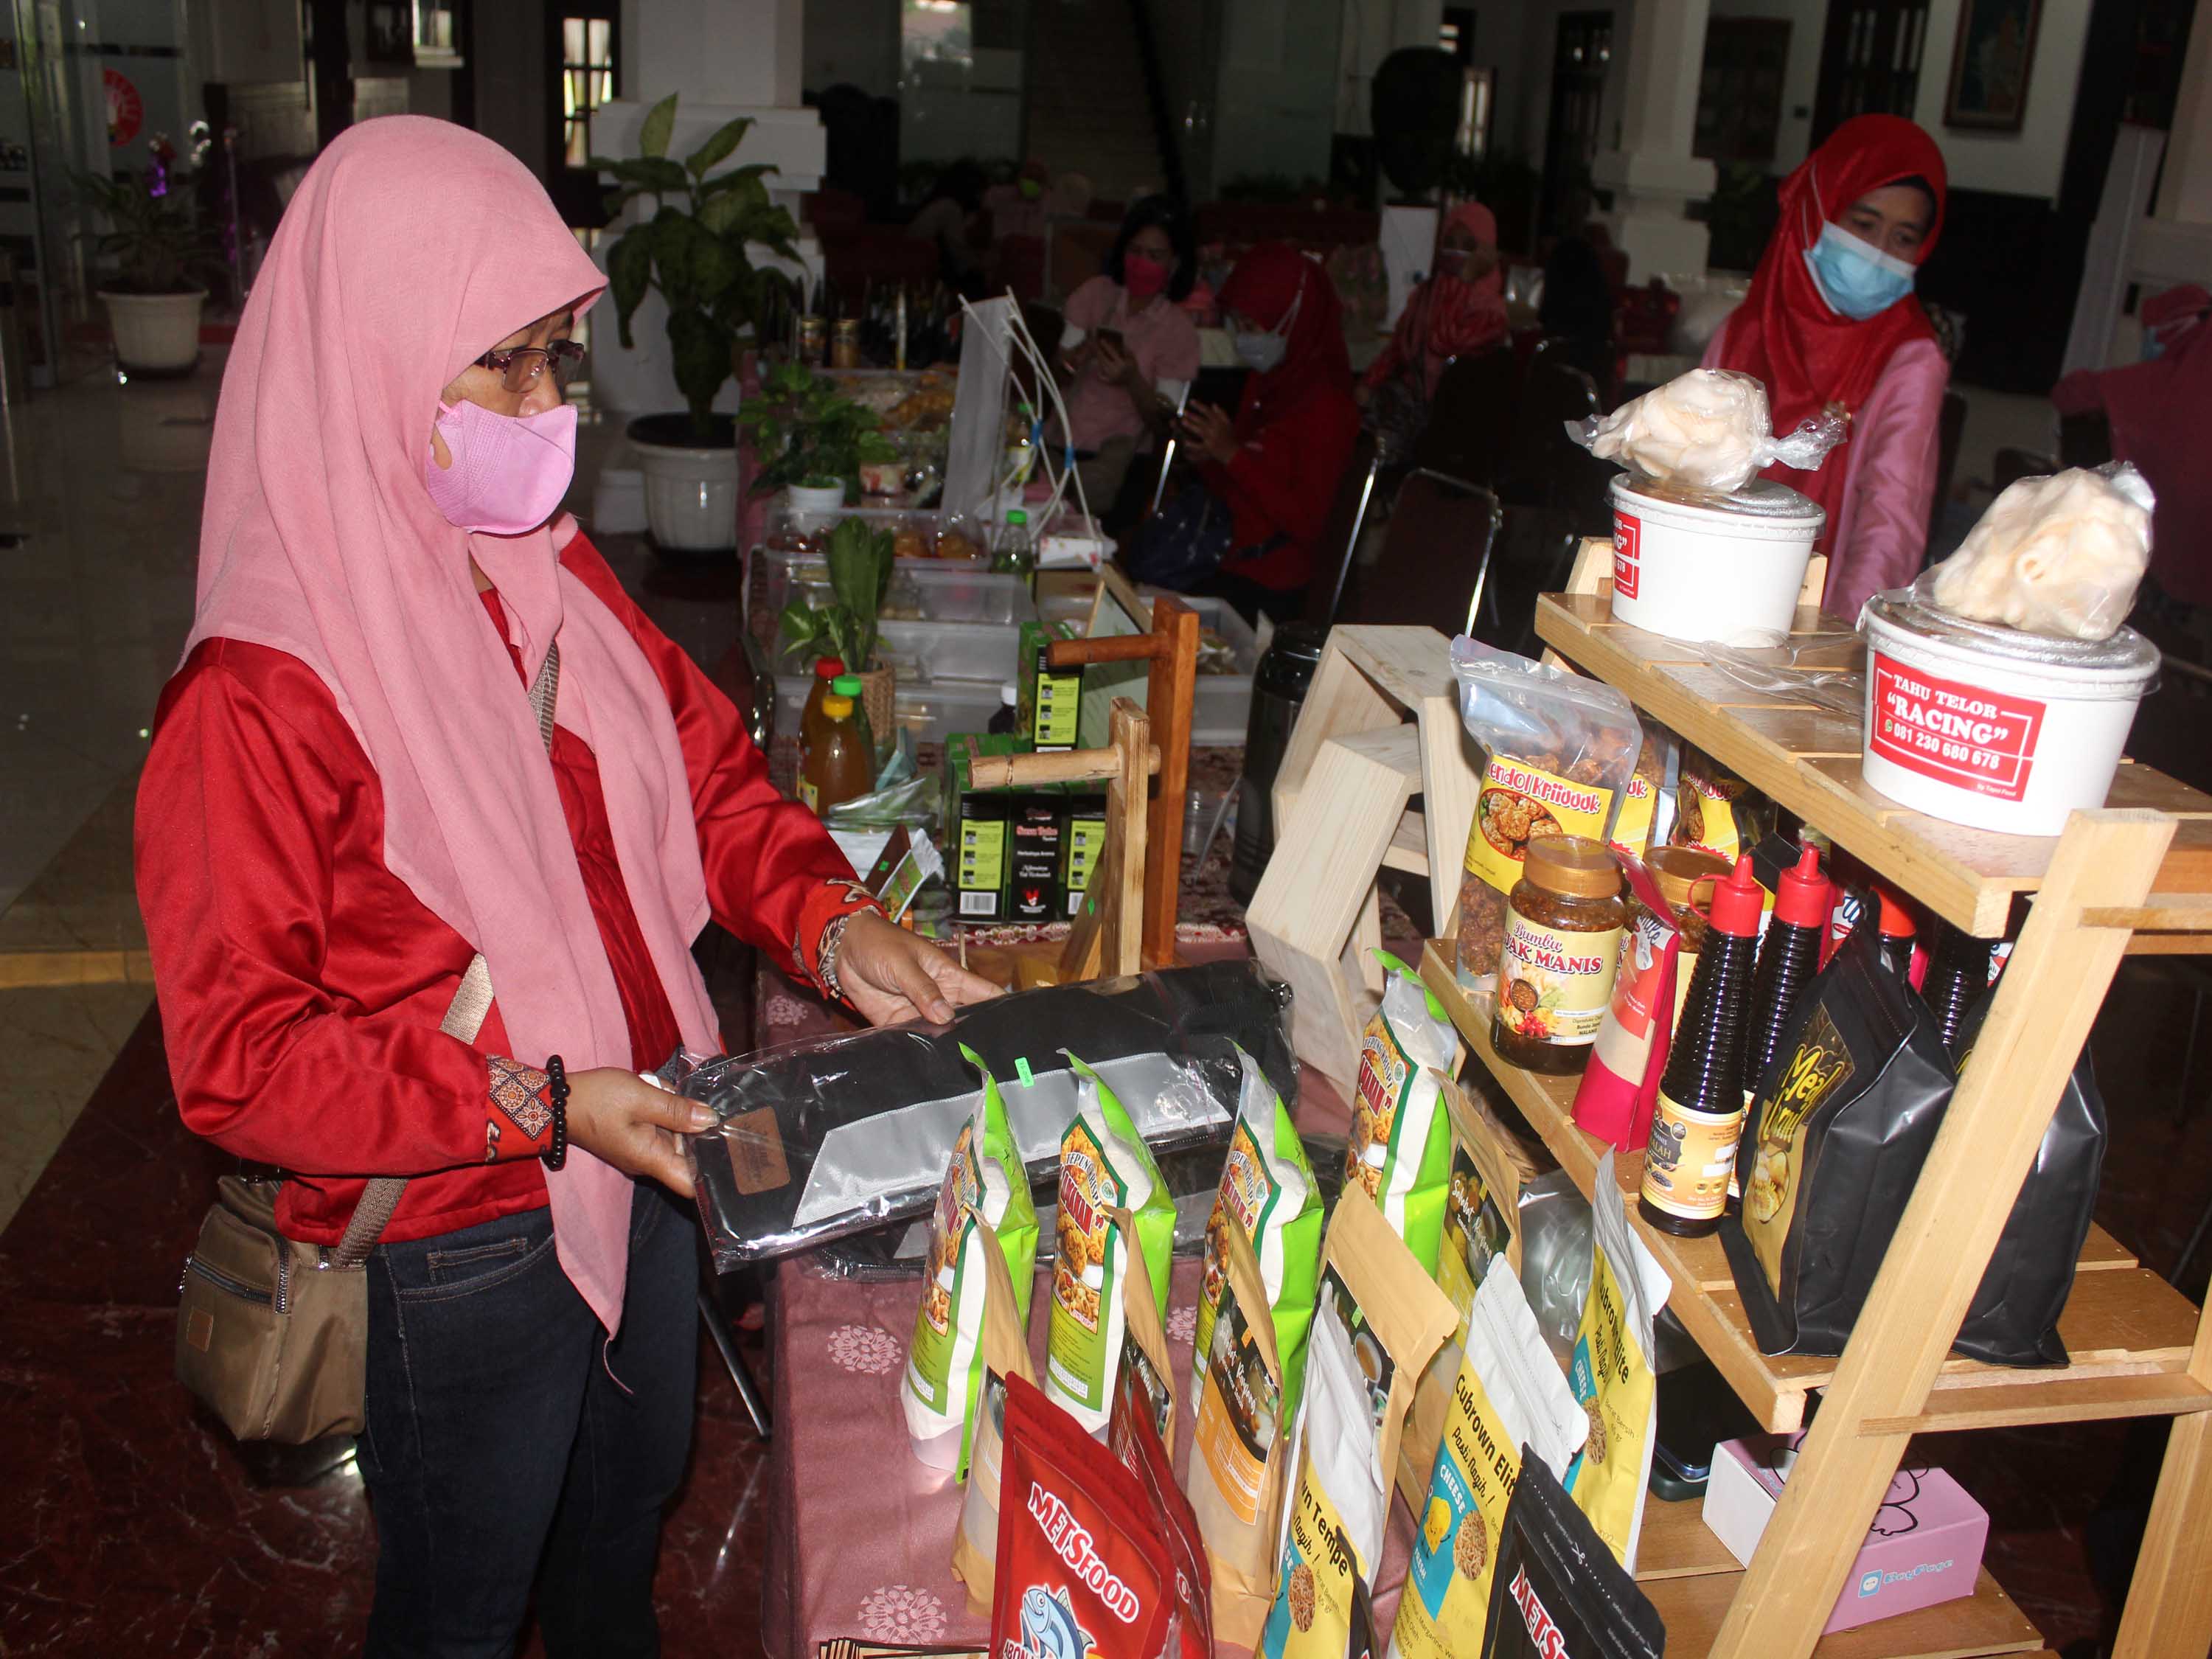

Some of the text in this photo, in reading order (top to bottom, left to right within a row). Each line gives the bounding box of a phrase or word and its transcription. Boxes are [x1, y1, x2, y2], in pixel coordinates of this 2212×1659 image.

[1893, 674, 1998, 720] TAHU TELOR
[1893, 722, 2000, 770] 081 230 680 678
[1489, 762, 1531, 794] endol
[1505, 932, 1604, 975] JAK MANIS
[1514, 921, 1563, 953] Bumbu
[1455, 1374, 1518, 1497] Cubrown Elit
[1451, 1425, 1471, 1464] Pasti
[1467, 1457, 1487, 1498] Nagih
[1439, 1464, 1466, 1514] CHEESE
[1027, 1481, 1140, 1624] METSFOOD
[1293, 1515, 1312, 1556] Nagih
[1312, 1502, 1349, 1577] Tempe
[1509, 1562, 1570, 1659] METS
